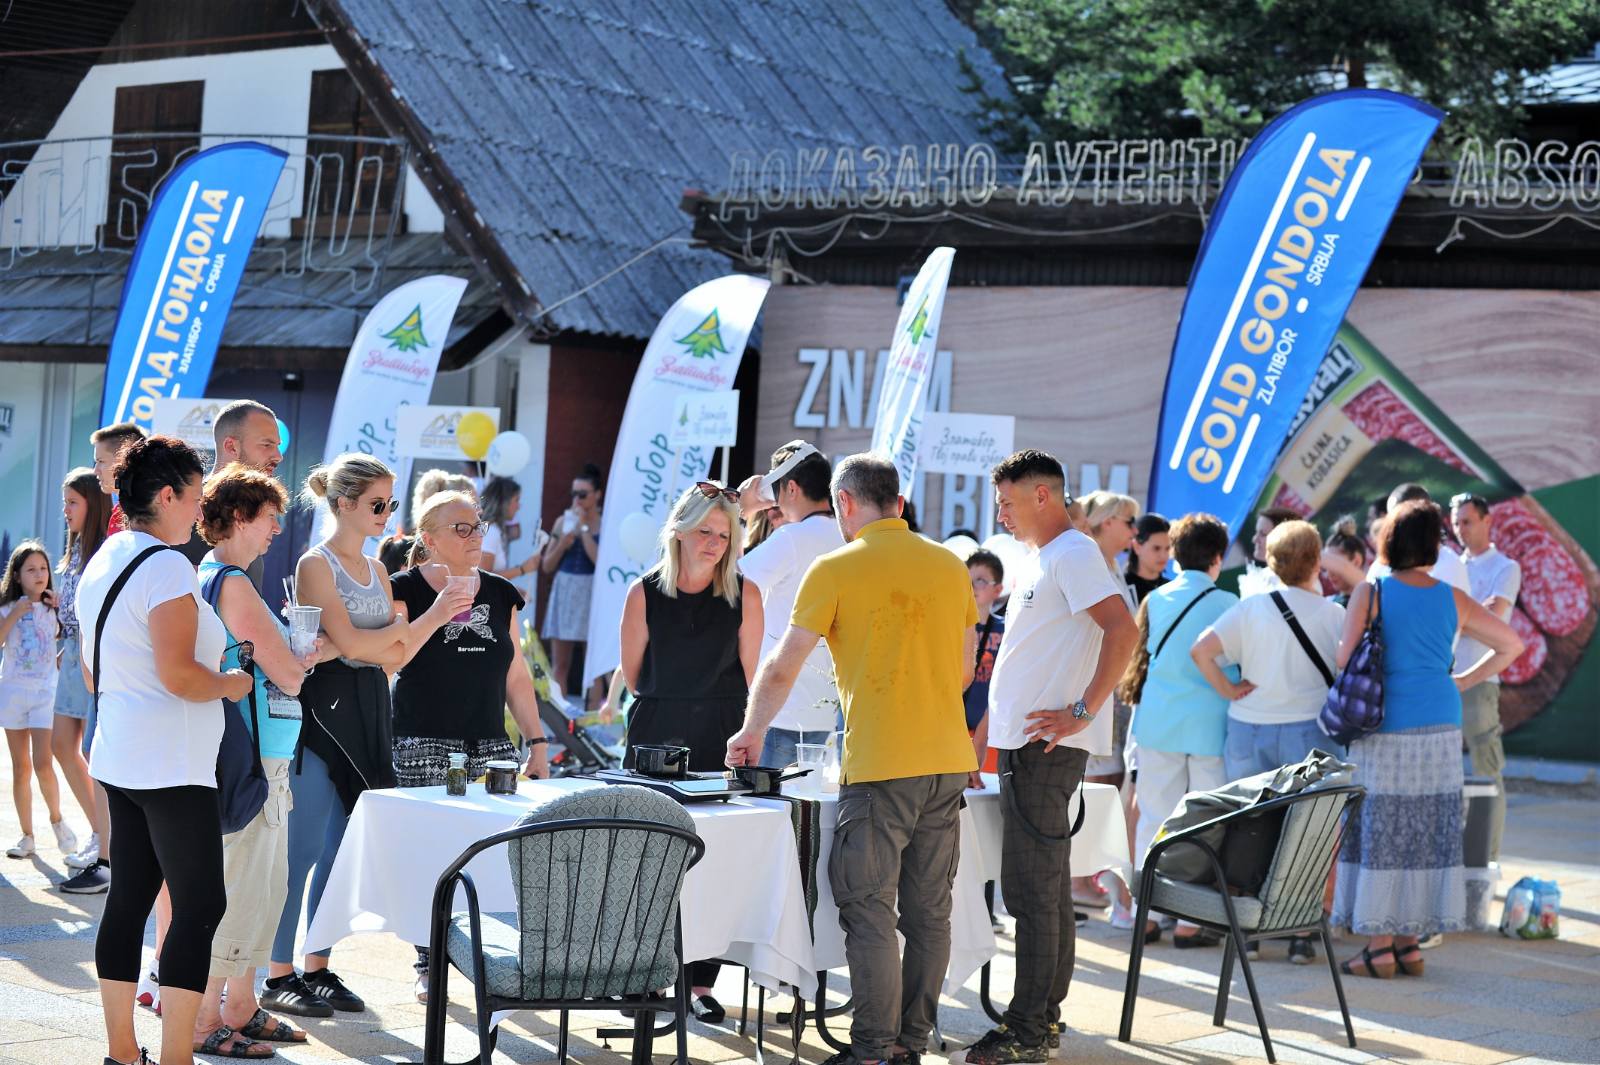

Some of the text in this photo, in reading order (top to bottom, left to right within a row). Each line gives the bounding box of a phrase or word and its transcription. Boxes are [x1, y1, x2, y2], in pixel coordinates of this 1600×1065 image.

[720, 142, 998, 222] ДОКАЗАНО
[129, 190, 229, 434] ОЛД ГОНДОЛА
[178, 317, 202, 375] ЗЛАТИБОР
[1187, 147, 1357, 483] GOLD GONDOLA
[1256, 233, 1340, 406] ZLATIBOR SRBIJA
[1306, 435, 1353, 490] KOBASICA
